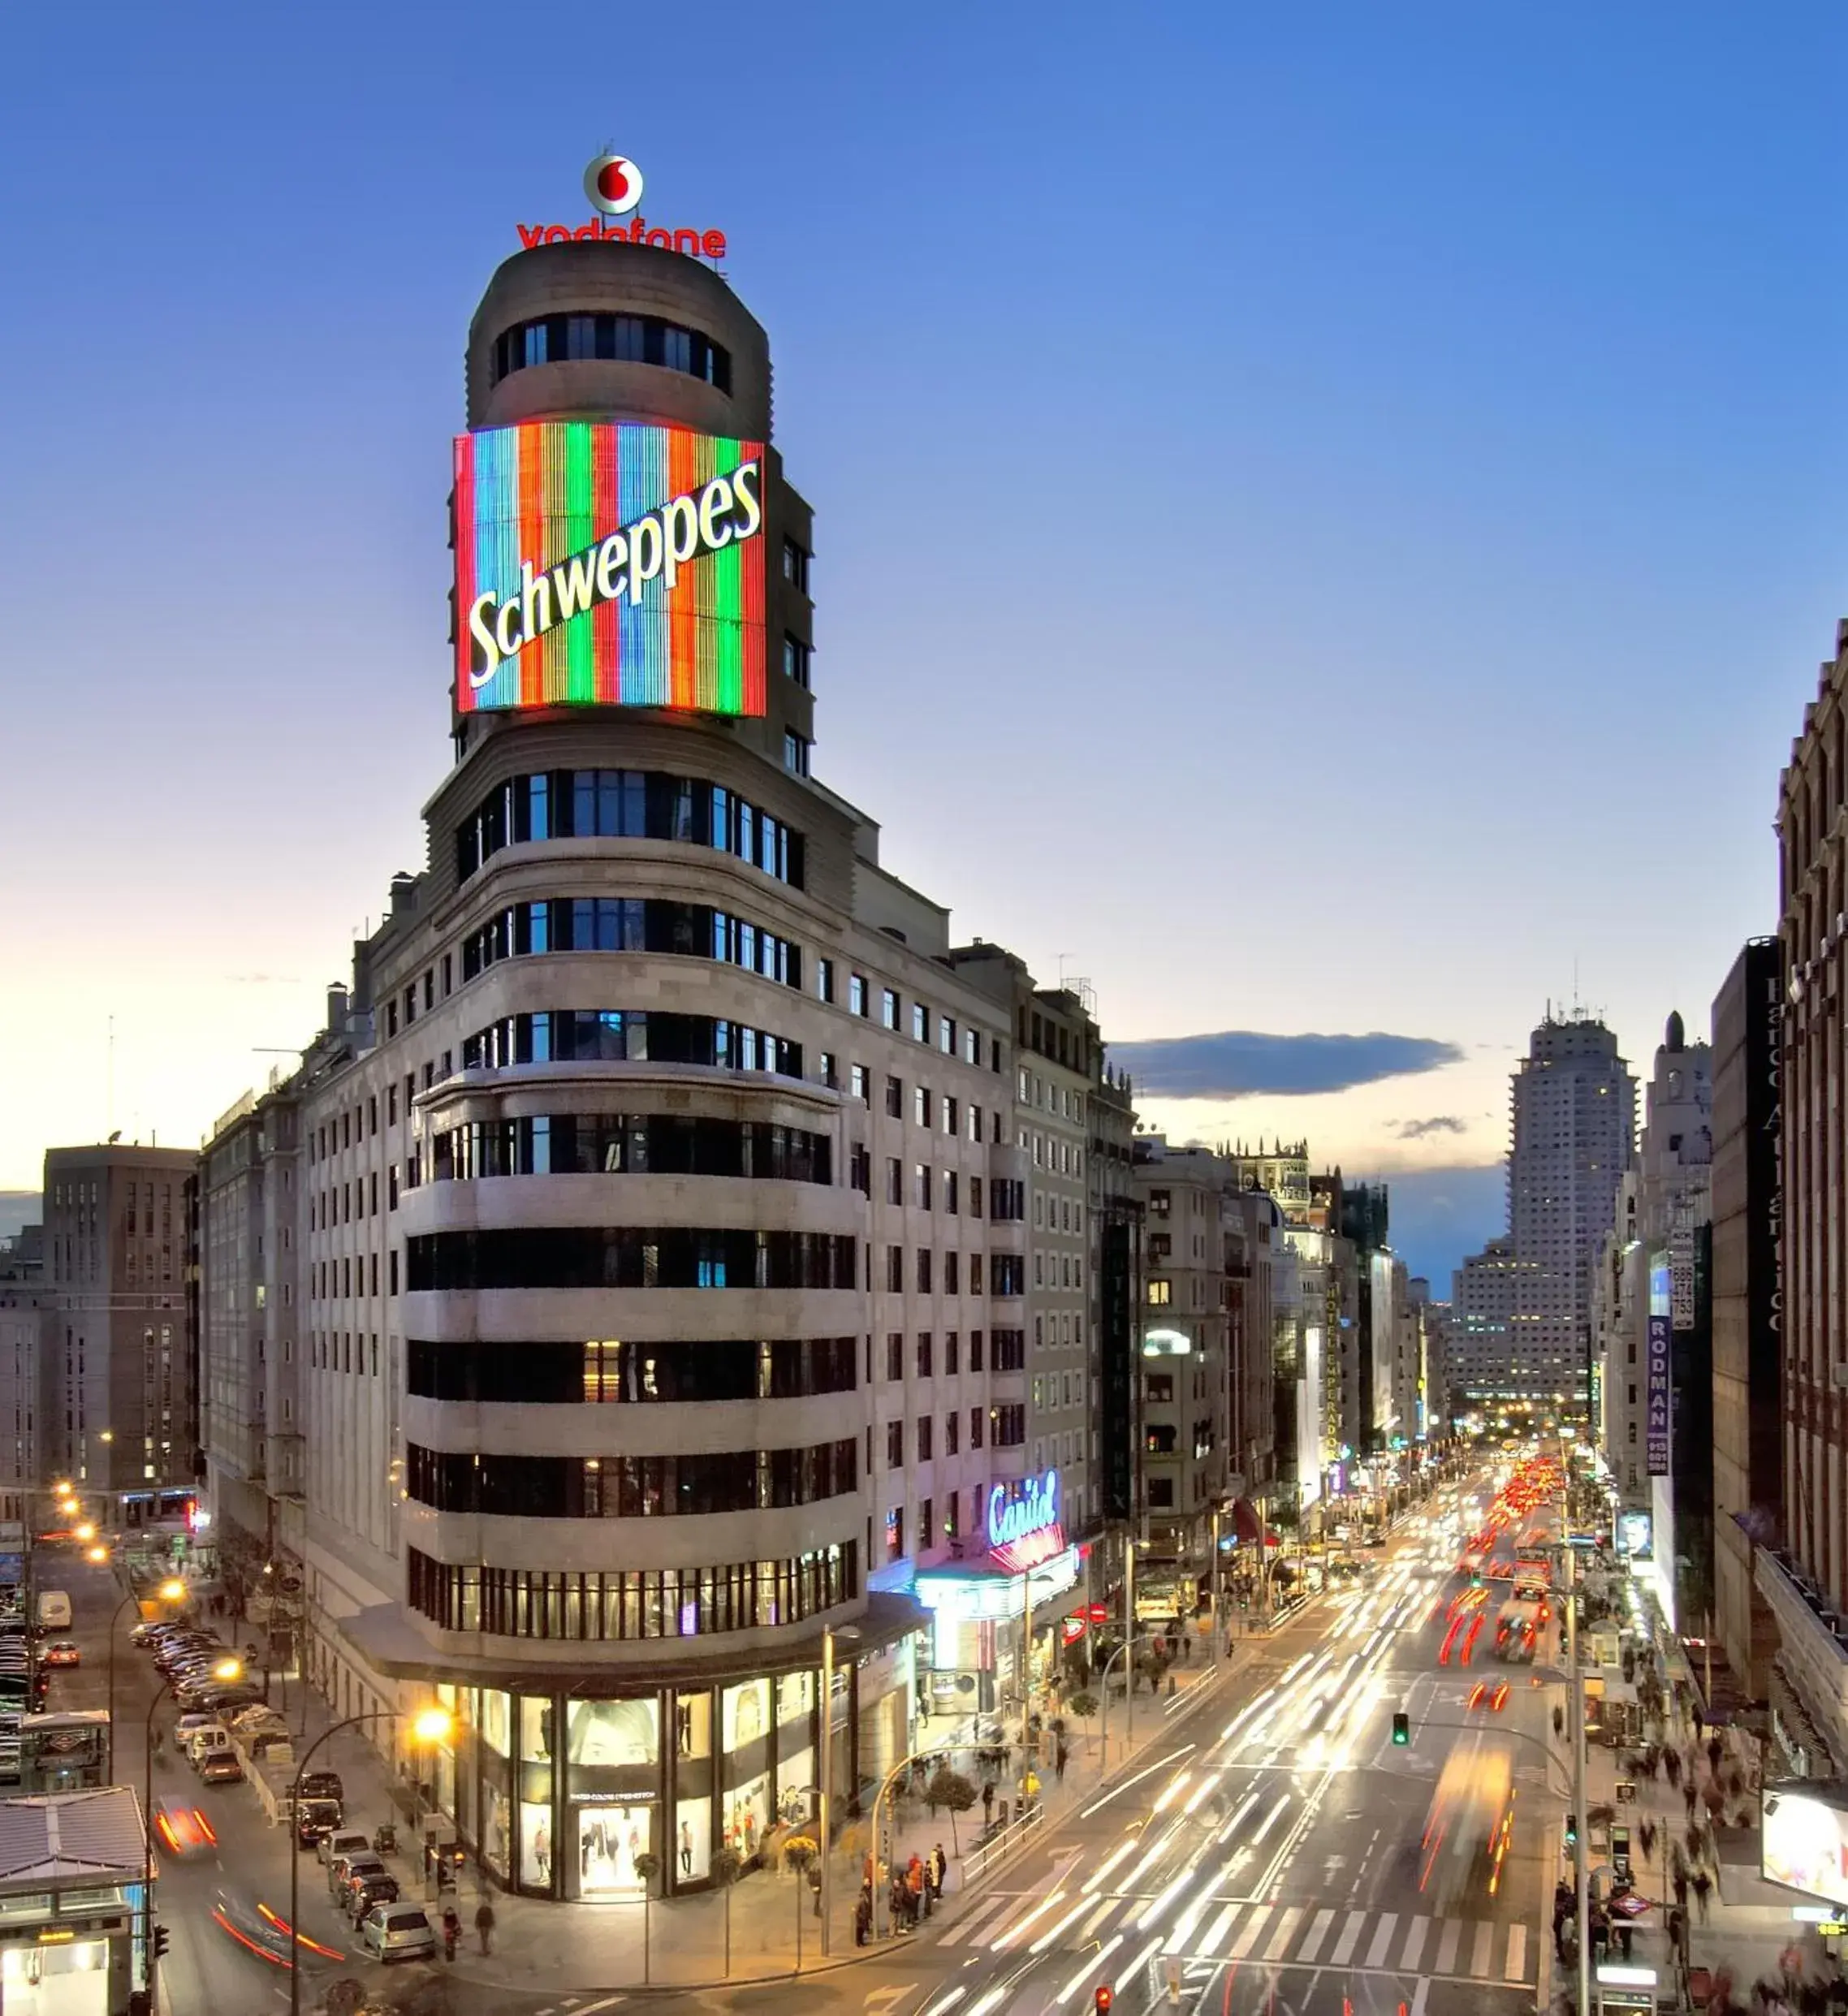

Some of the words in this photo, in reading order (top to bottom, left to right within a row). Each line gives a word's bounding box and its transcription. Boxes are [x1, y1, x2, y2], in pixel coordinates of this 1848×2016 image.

[516, 217, 727, 258] vodafone
[468, 460, 762, 689] Schweppes
[1327, 1288, 1336, 1349] HOTEL
[1327, 1354, 1337, 1460] EMPERADOR
[1651, 1322, 1667, 1426] RODMAN
